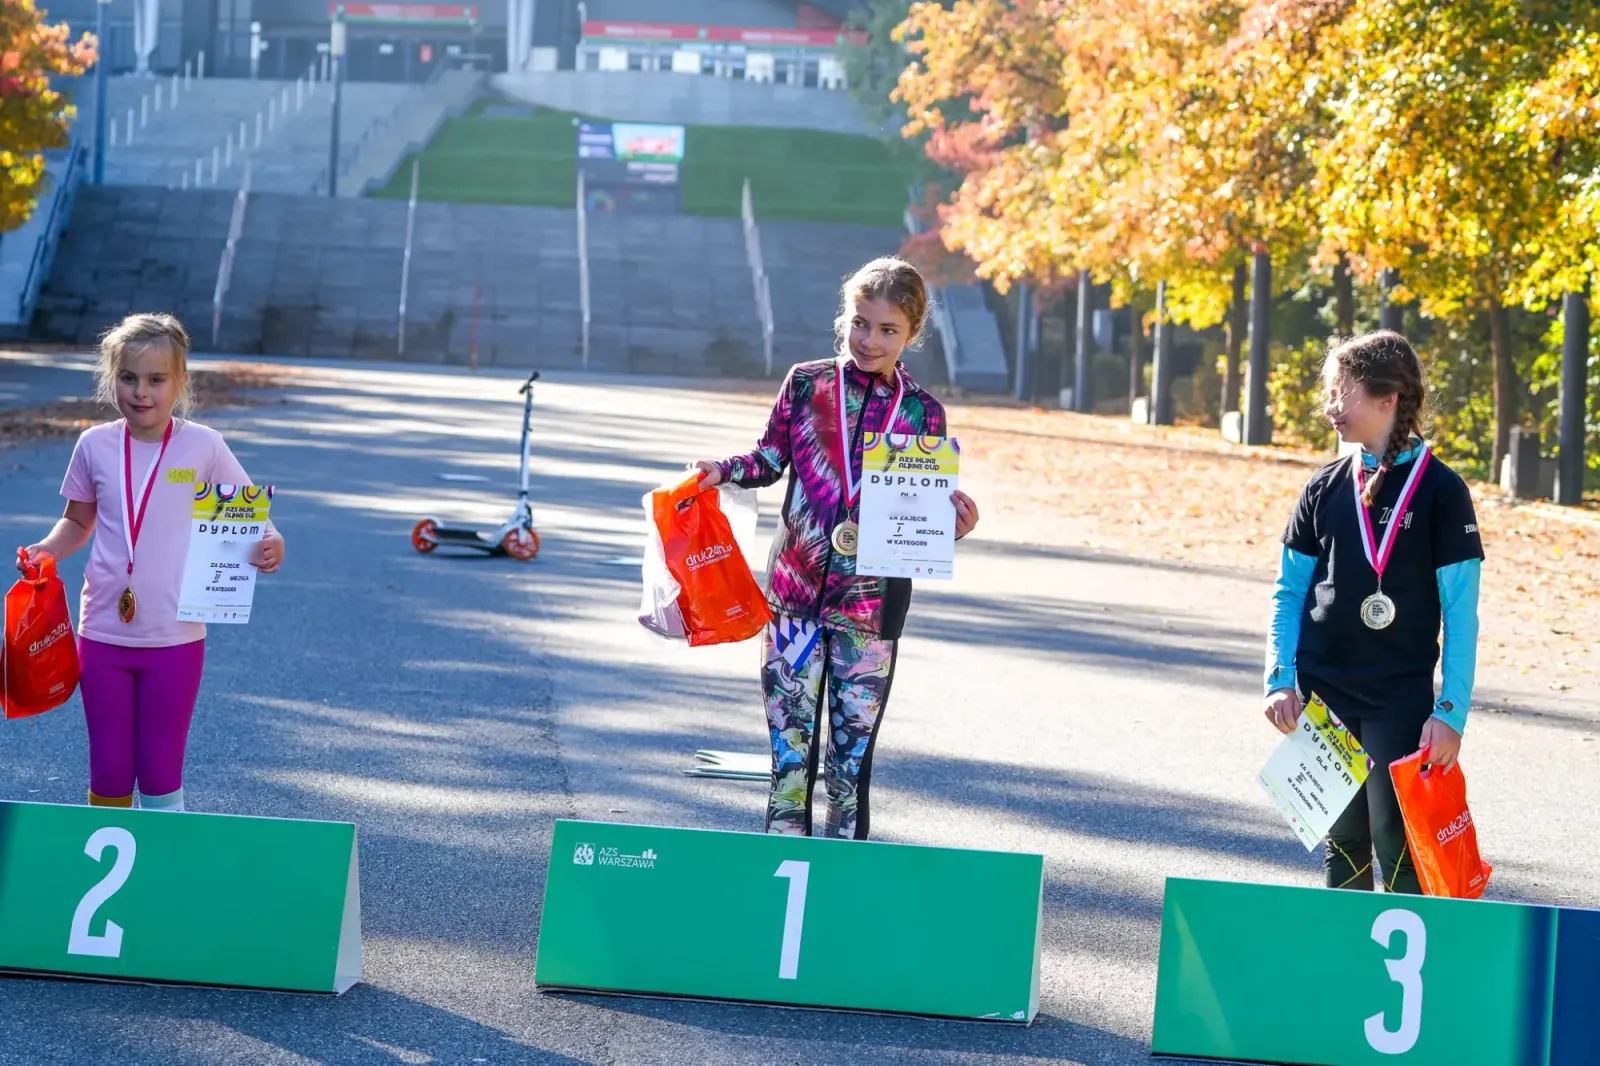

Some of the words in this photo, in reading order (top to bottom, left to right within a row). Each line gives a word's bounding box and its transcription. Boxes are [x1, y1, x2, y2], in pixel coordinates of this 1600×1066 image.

[871, 475, 949, 488] DYPLOM
[199, 524, 259, 535] DYPLOM
[1304, 722, 1353, 786] DYPLOM
[1300, 762, 1307, 772] ZA
[1316, 756, 1328, 772] DLA
[1310, 792, 1329, 816] MIEJSCA
[599, 847, 618, 857] AZS
[599, 857, 655, 869] WARSZAWA
[67, 826, 137, 958] 2
[773, 860, 810, 980] 1
[1364, 908, 1427, 1055] 3
